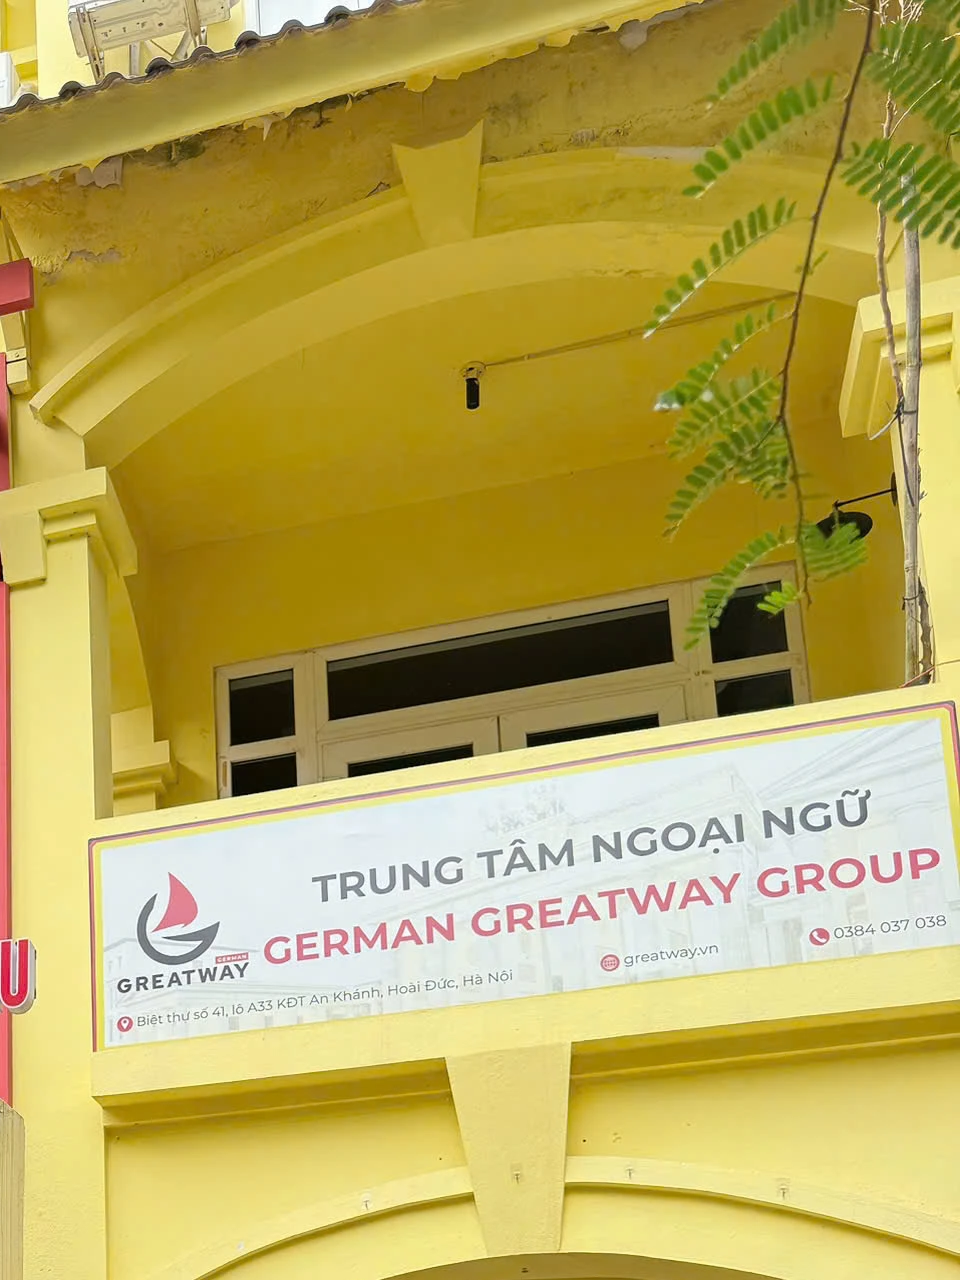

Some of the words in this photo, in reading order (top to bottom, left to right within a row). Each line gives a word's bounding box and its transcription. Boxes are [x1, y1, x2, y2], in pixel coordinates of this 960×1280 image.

[311, 856, 464, 902] TRUNG
[476, 838, 575, 879] TÂM
[591, 813, 745, 863] NGOẠI
[761, 788, 872, 839] NGỮ
[263, 913, 456, 965] GERMAN
[471, 872, 741, 937] GREATWAY
[756, 847, 941, 898] GROUP
[833, 925, 876, 940] 0384
[880, 918, 910, 934] 037
[915, 914, 947, 929] 038
[216, 953, 248, 964] GERMAN
[623, 942, 720, 969] greatway.vn
[117, 961, 250, 994] GREATWAY
[193, 1006, 209, 1020] số
[247, 999, 273, 1014] A33
[277, 995, 305, 1010] KĐT
[309, 993, 329, 1006] An
[333, 986, 384, 1003] Khánh,
[387, 981, 421, 996] Hoài
[463, 973, 483, 987] Hà
[488, 968, 514, 985] Nội
